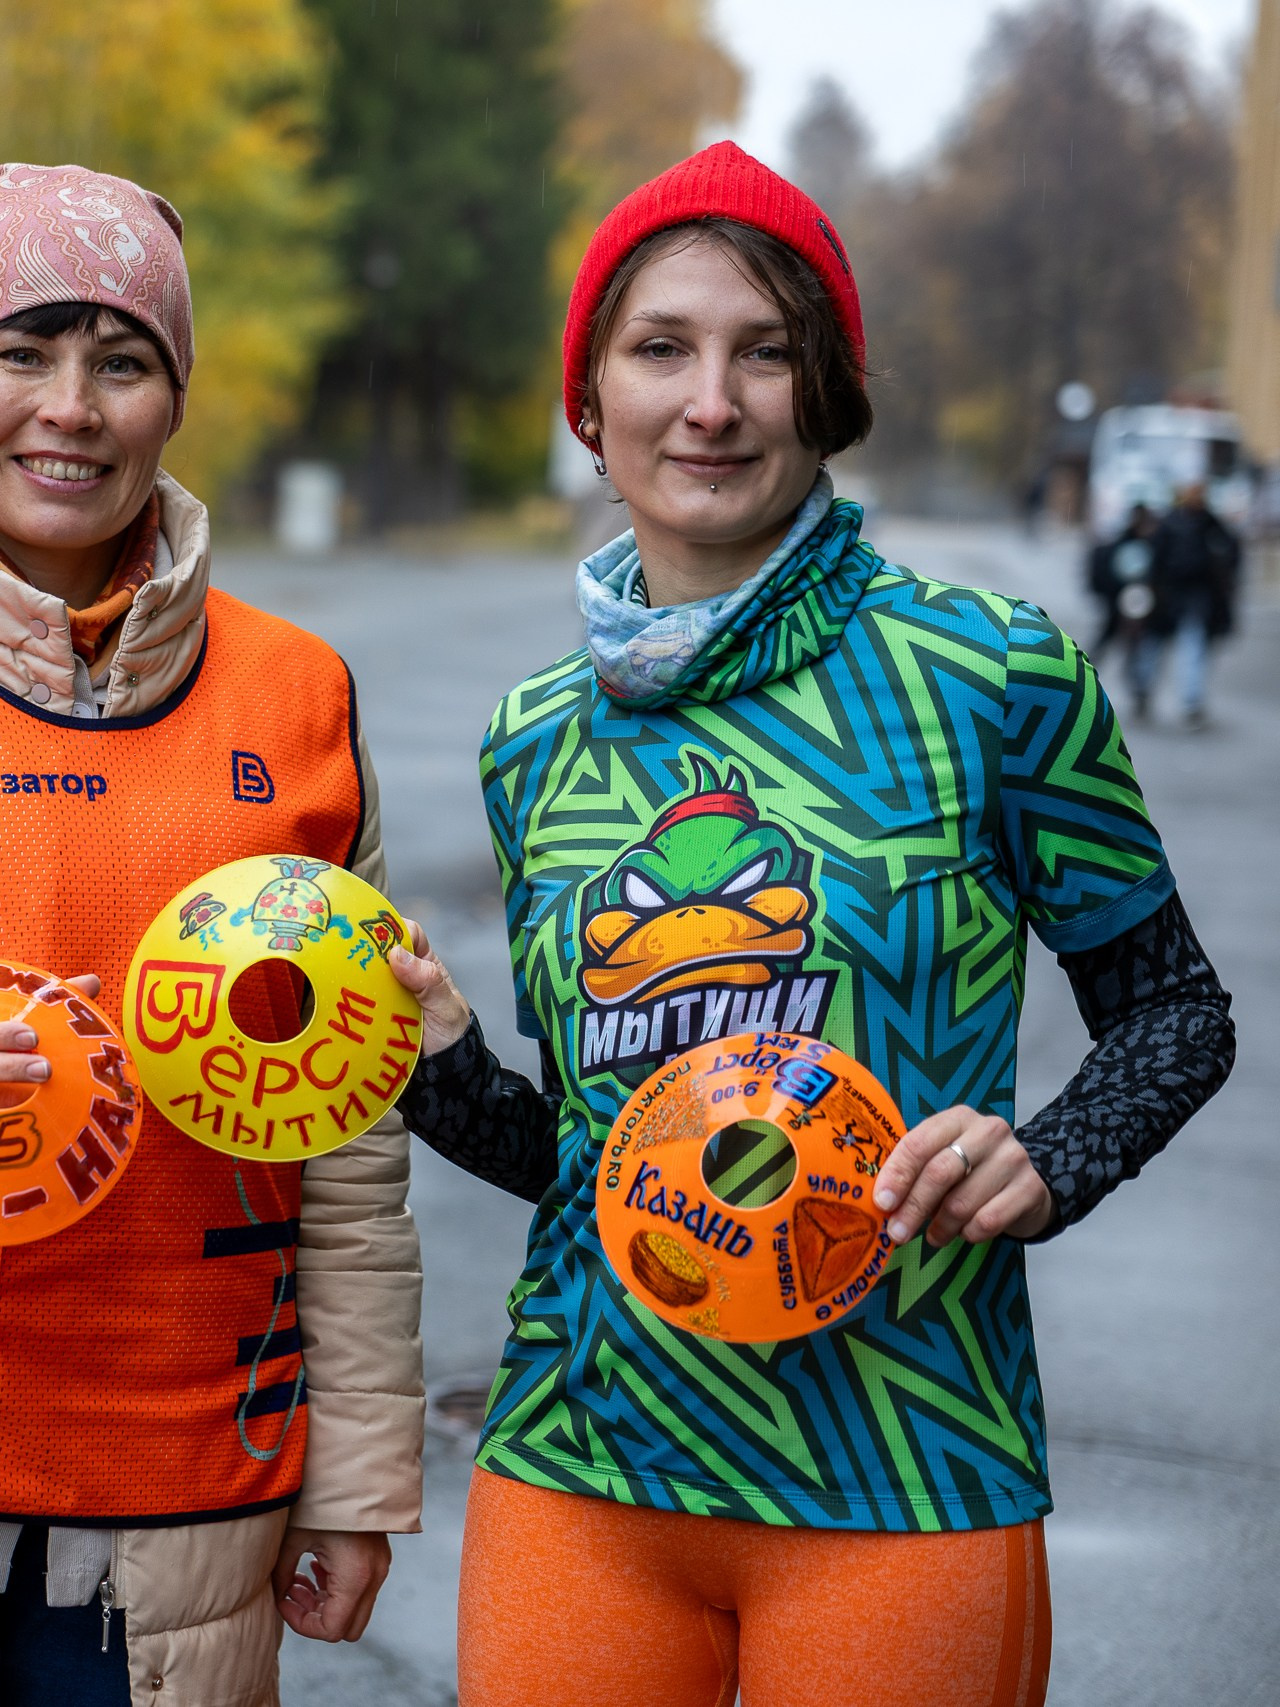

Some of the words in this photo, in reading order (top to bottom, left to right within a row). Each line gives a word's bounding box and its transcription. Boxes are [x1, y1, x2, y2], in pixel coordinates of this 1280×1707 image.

[582, 976, 828, 1068] МЫТИЩИ
[169, 1013, 420, 1150] МЫТИЩИ
[711, 1081, 760, 1104] 9:00
